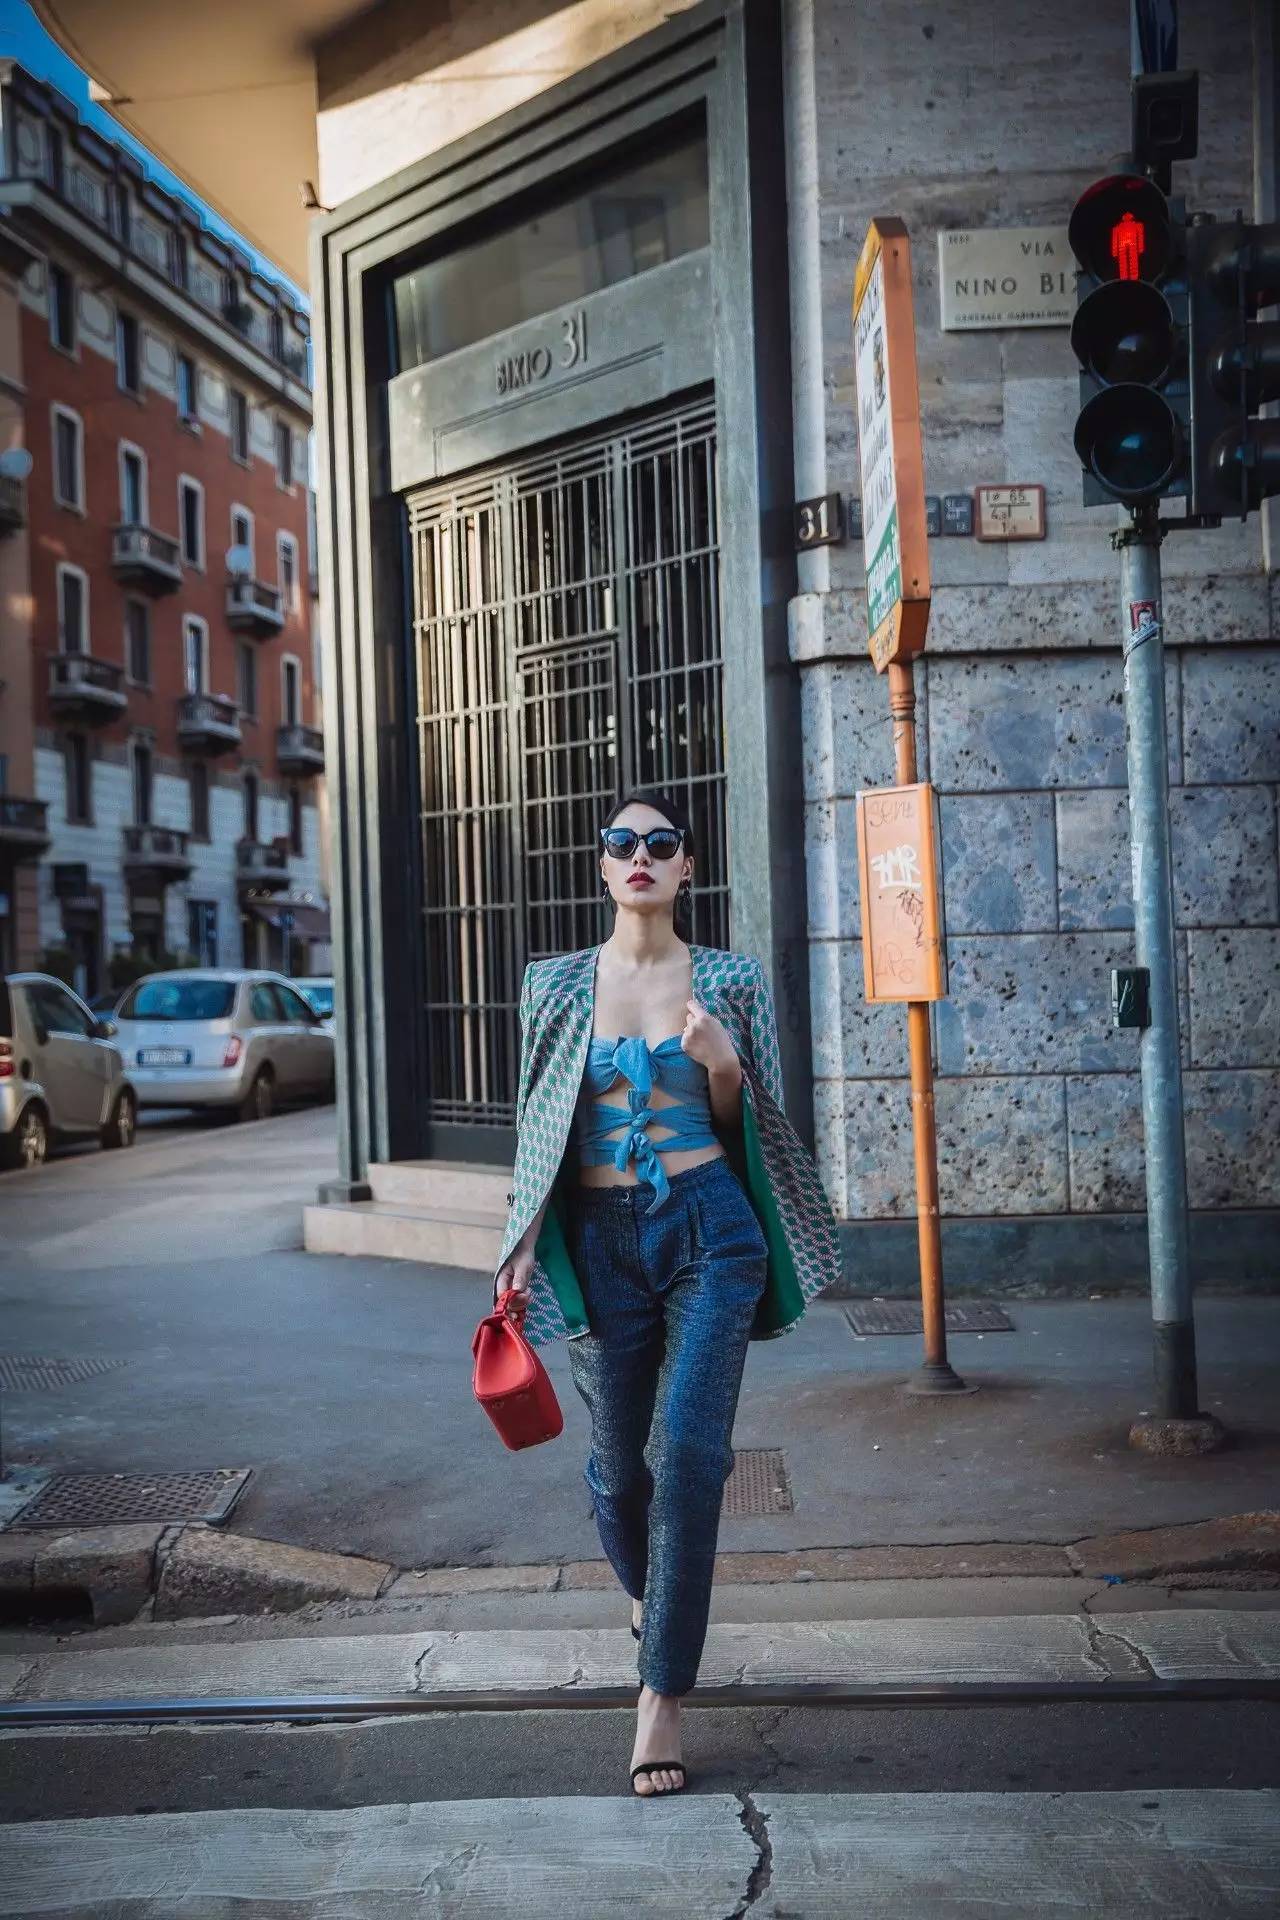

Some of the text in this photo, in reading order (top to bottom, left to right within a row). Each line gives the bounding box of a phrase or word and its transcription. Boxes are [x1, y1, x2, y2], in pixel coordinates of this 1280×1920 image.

[1020, 241, 1055, 256] VIA
[955, 277, 1017, 296] NINO
[496, 309, 588, 396] BIXIO 31
[799, 500, 829, 541] 31
